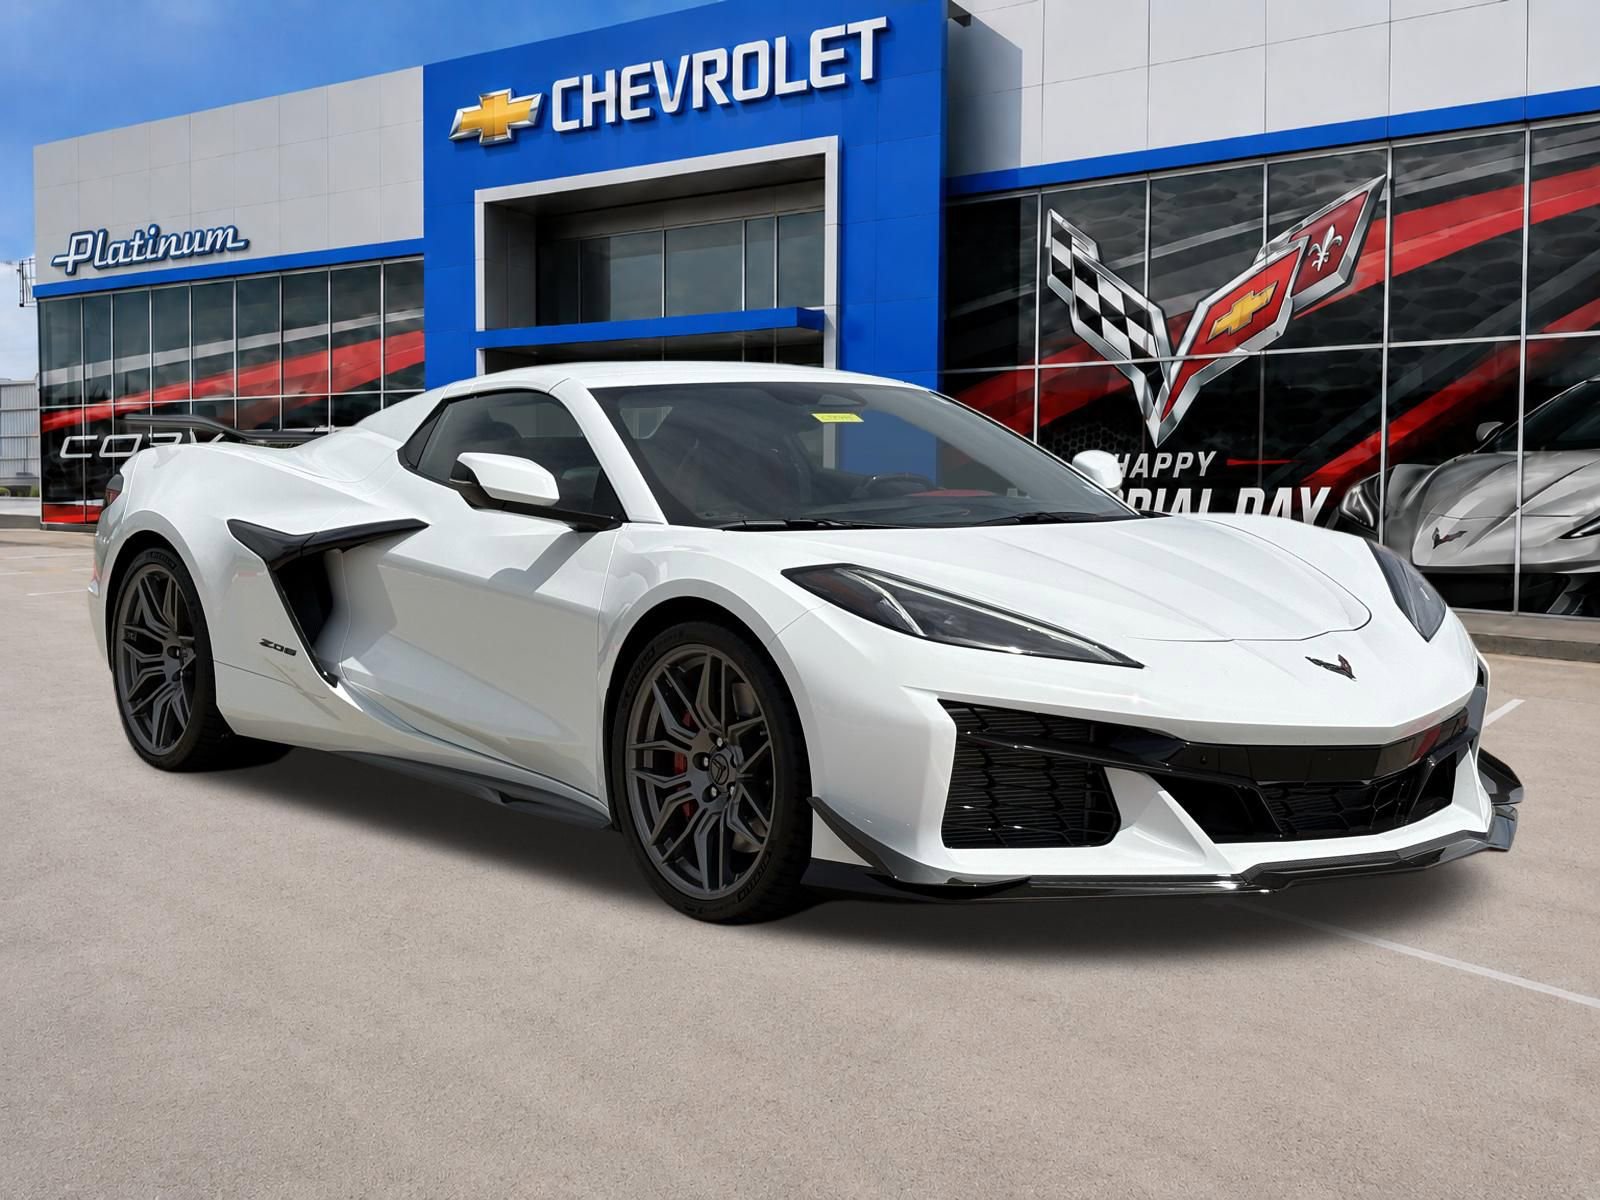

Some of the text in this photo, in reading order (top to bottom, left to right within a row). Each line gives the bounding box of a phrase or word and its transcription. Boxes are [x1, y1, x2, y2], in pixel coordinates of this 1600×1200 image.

[551, 16, 887, 132] CHEVROLET
[51, 224, 250, 275] Platinum
[1115, 450, 1217, 478] HAPPY
[1235, 486, 1332, 525] DAY
